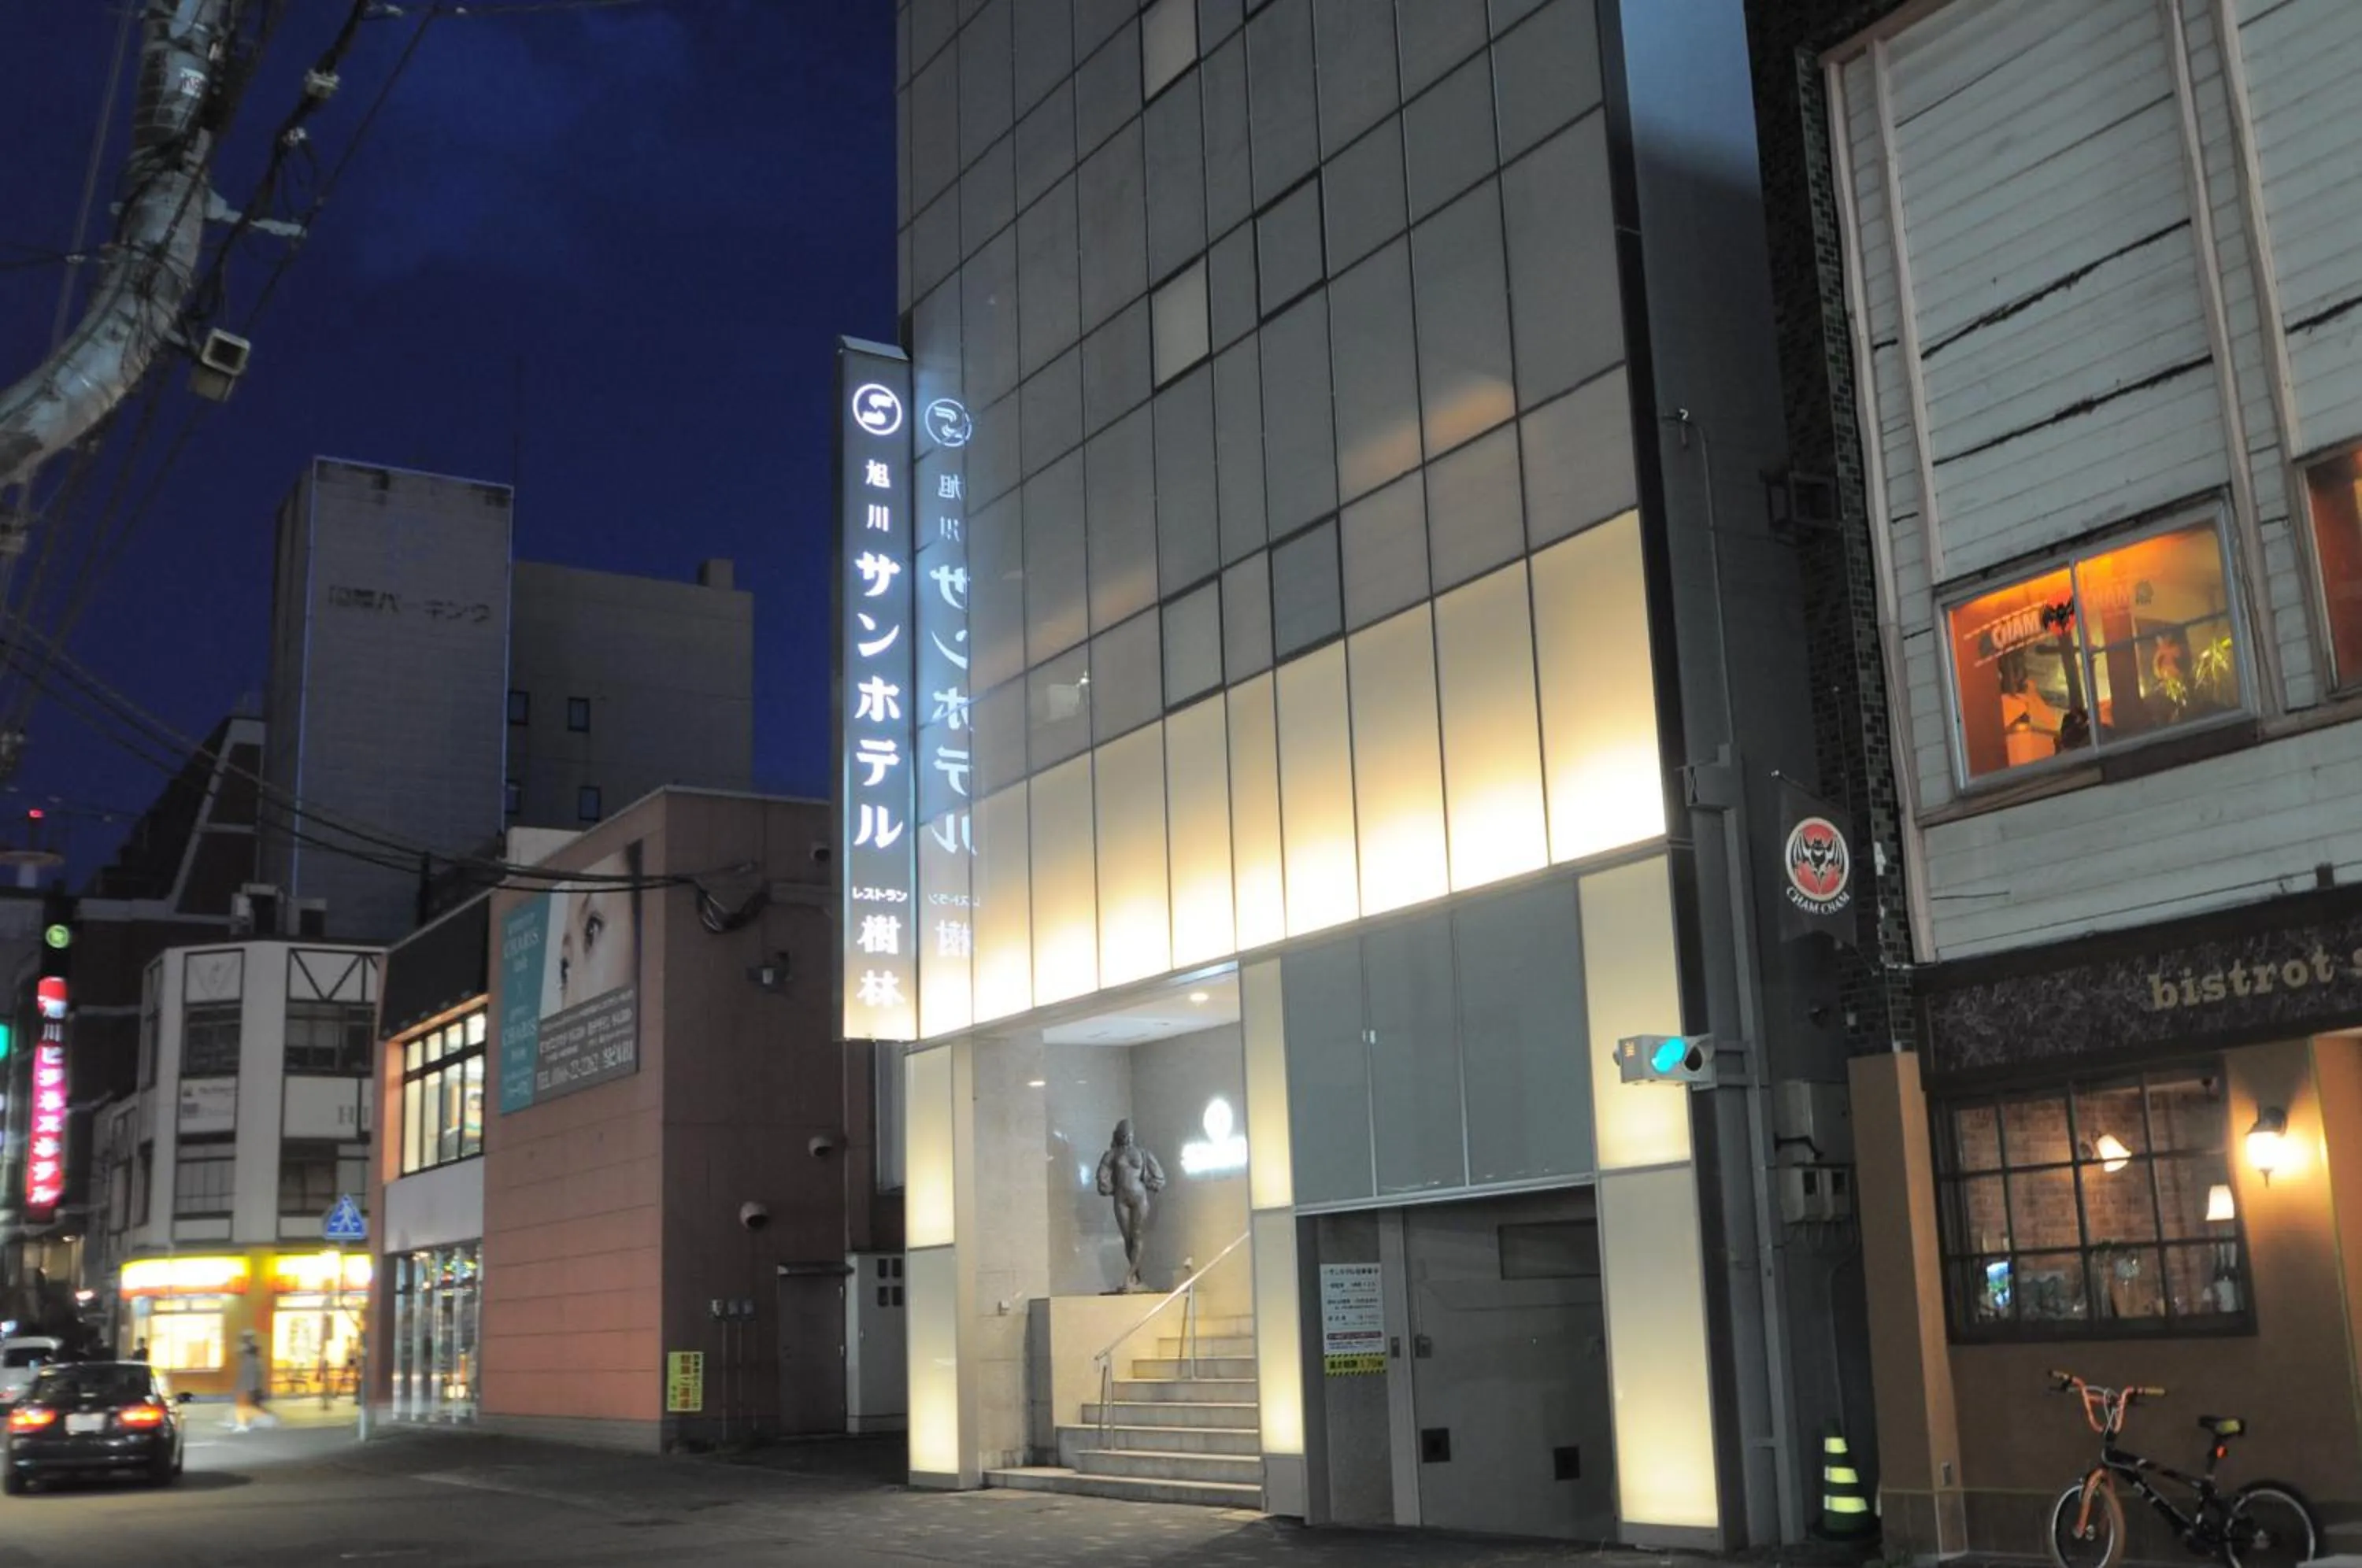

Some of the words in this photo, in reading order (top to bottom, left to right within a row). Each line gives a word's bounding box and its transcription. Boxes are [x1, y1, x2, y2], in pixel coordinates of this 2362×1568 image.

[852, 886, 908, 904] レストラン
[1786, 886, 1819, 915] CHAM
[1820, 890, 1850, 915] CHAM
[857, 914, 905, 1008] 樹林
[2148, 945, 2336, 1011] bistrot
